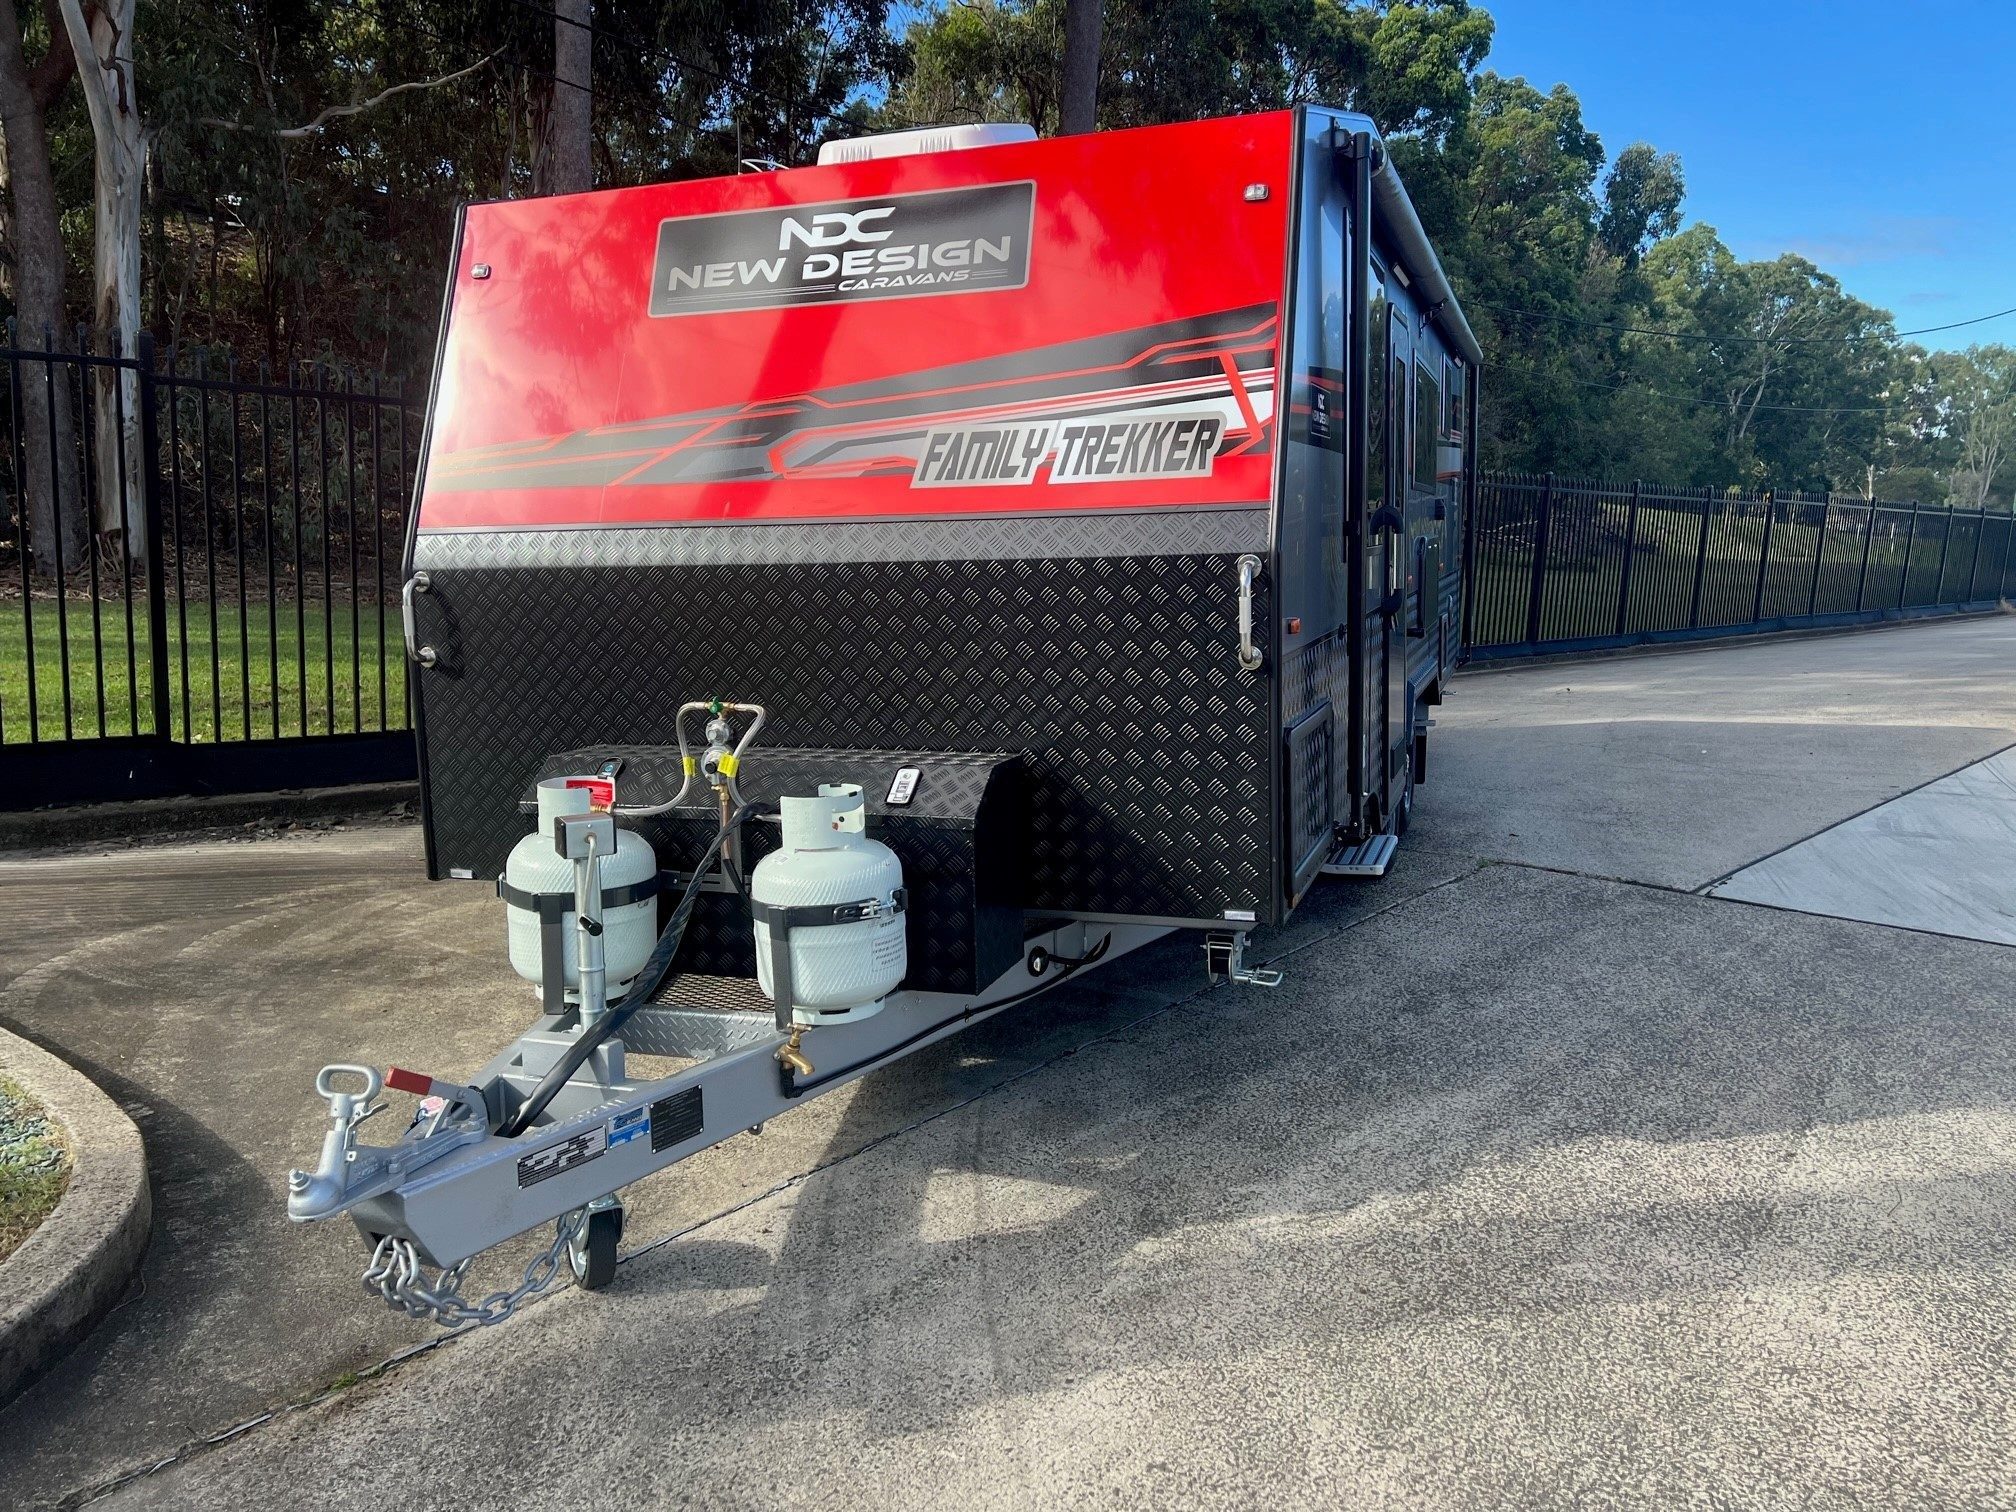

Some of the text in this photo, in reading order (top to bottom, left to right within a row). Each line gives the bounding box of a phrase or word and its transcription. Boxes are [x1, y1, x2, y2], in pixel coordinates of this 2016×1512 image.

[778, 206, 896, 250] NDC
[668, 235, 1011, 291] NEW DESIGN
[838, 269, 971, 292] CARAVANS
[918, 418, 1221, 482] FAMILY TREKKER
